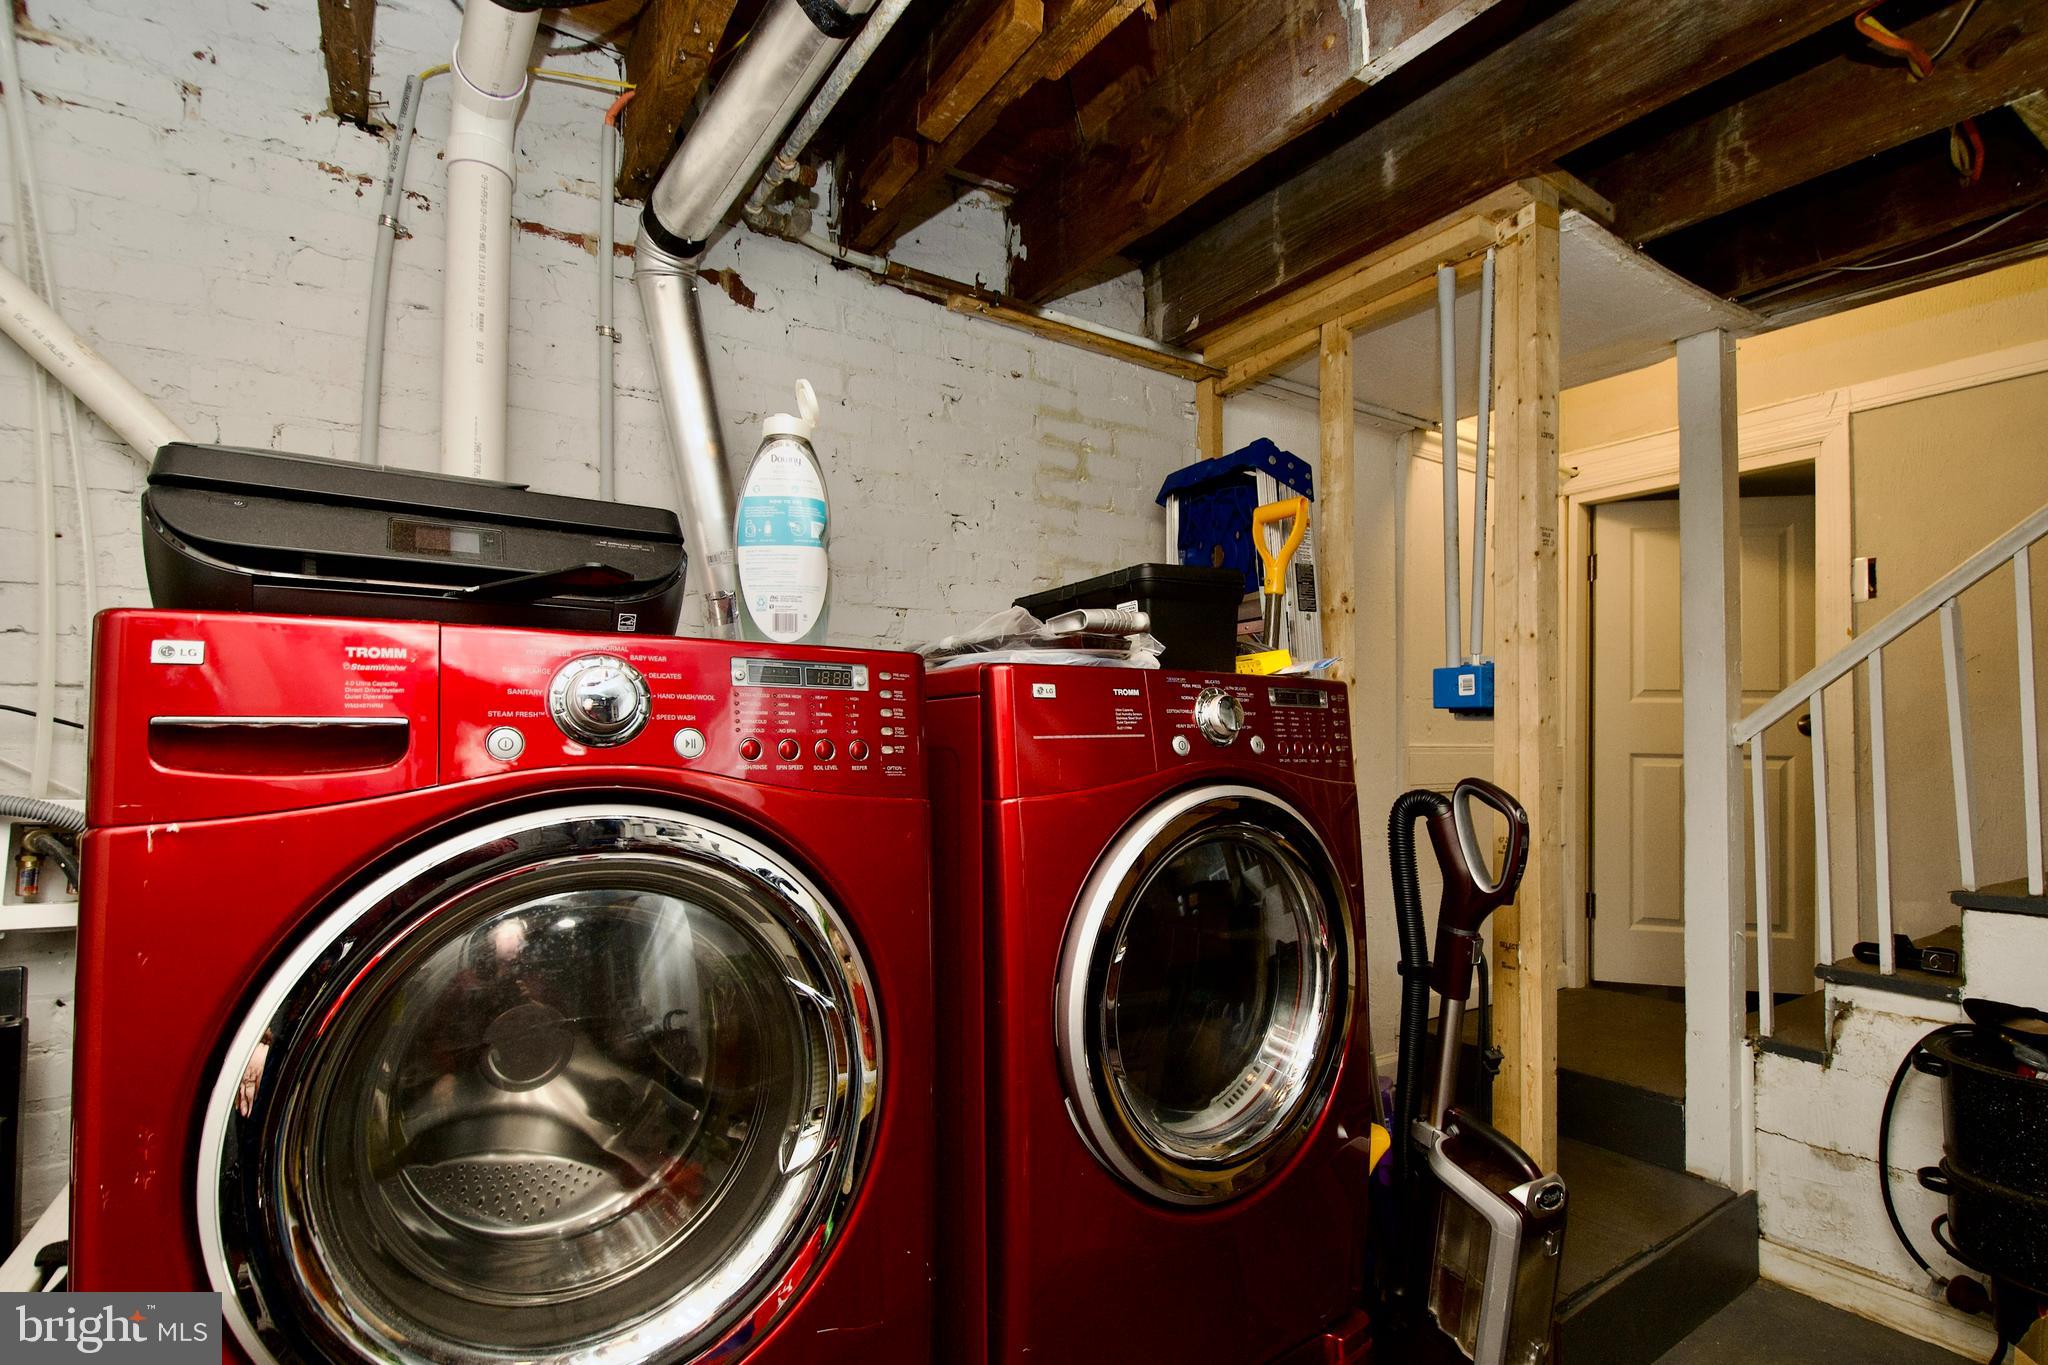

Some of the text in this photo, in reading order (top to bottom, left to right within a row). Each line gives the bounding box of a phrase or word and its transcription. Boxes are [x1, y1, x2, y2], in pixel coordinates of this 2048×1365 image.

[770, 454, 802, 466] Downy
[180, 648, 197, 656] LG
[344, 646, 407, 659] TROMM
[630, 654, 647, 662] BABY
[351, 663, 407, 671] SteamWasher
[648, 672, 682, 680] DELICATES
[507, 688, 543, 696] SANITARY
[1112, 688, 1140, 696] TROMM
